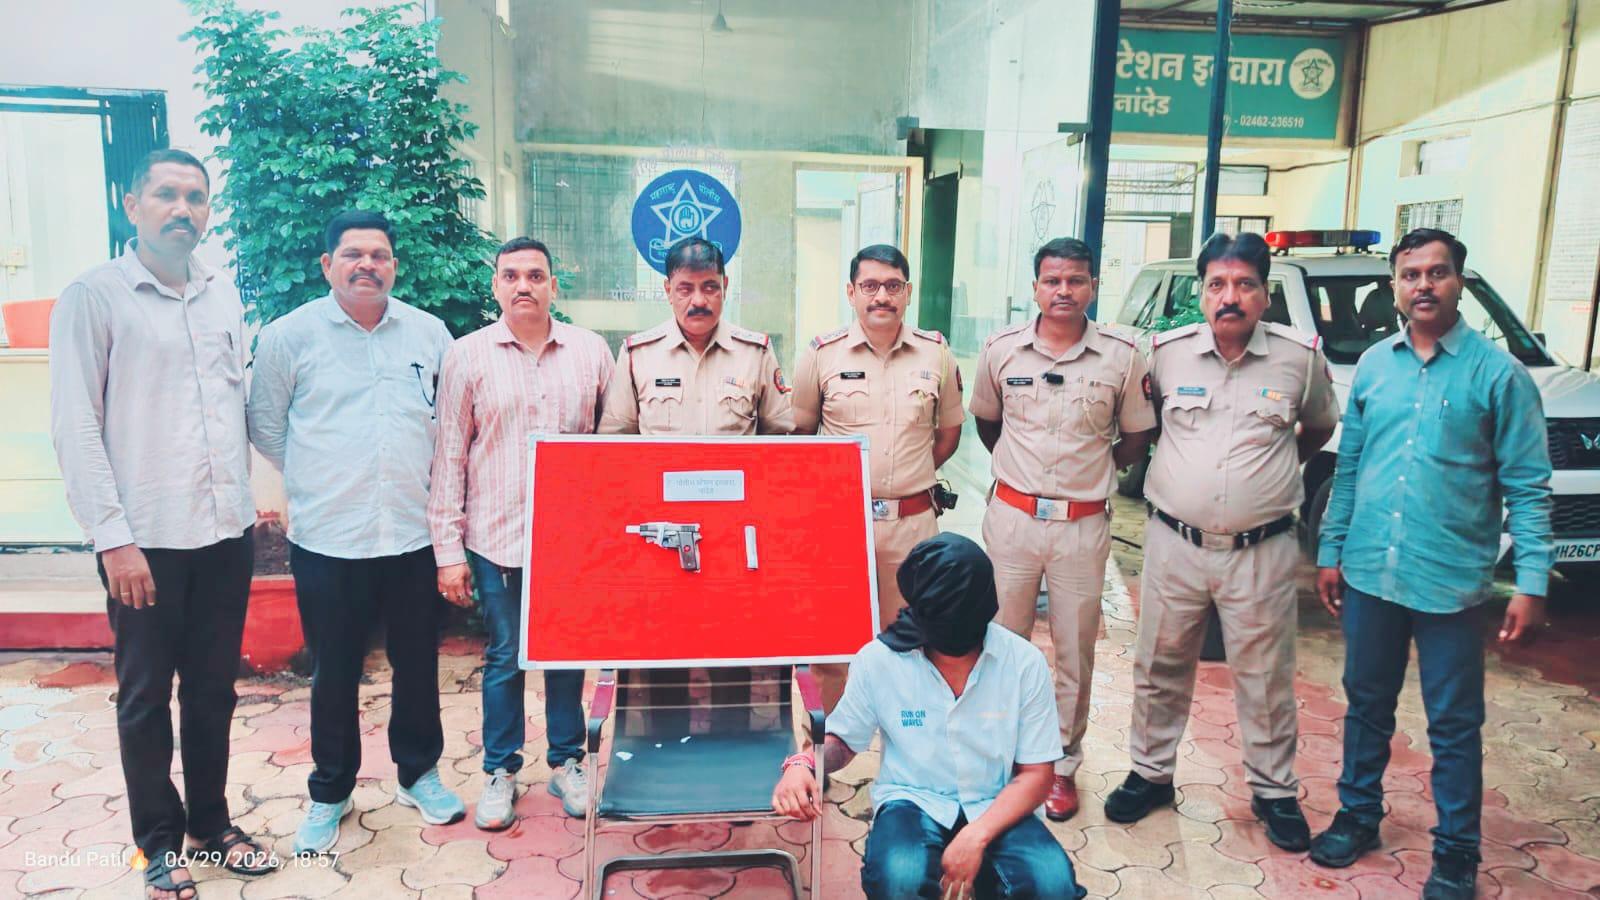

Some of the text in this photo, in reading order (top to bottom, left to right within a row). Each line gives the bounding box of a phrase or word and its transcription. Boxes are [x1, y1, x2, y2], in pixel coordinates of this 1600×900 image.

[1116, 39, 1186, 81] टेशन
[1113, 86, 1172, 117] नांदेड
[1240, 114, 1304, 129] 02462-236510
